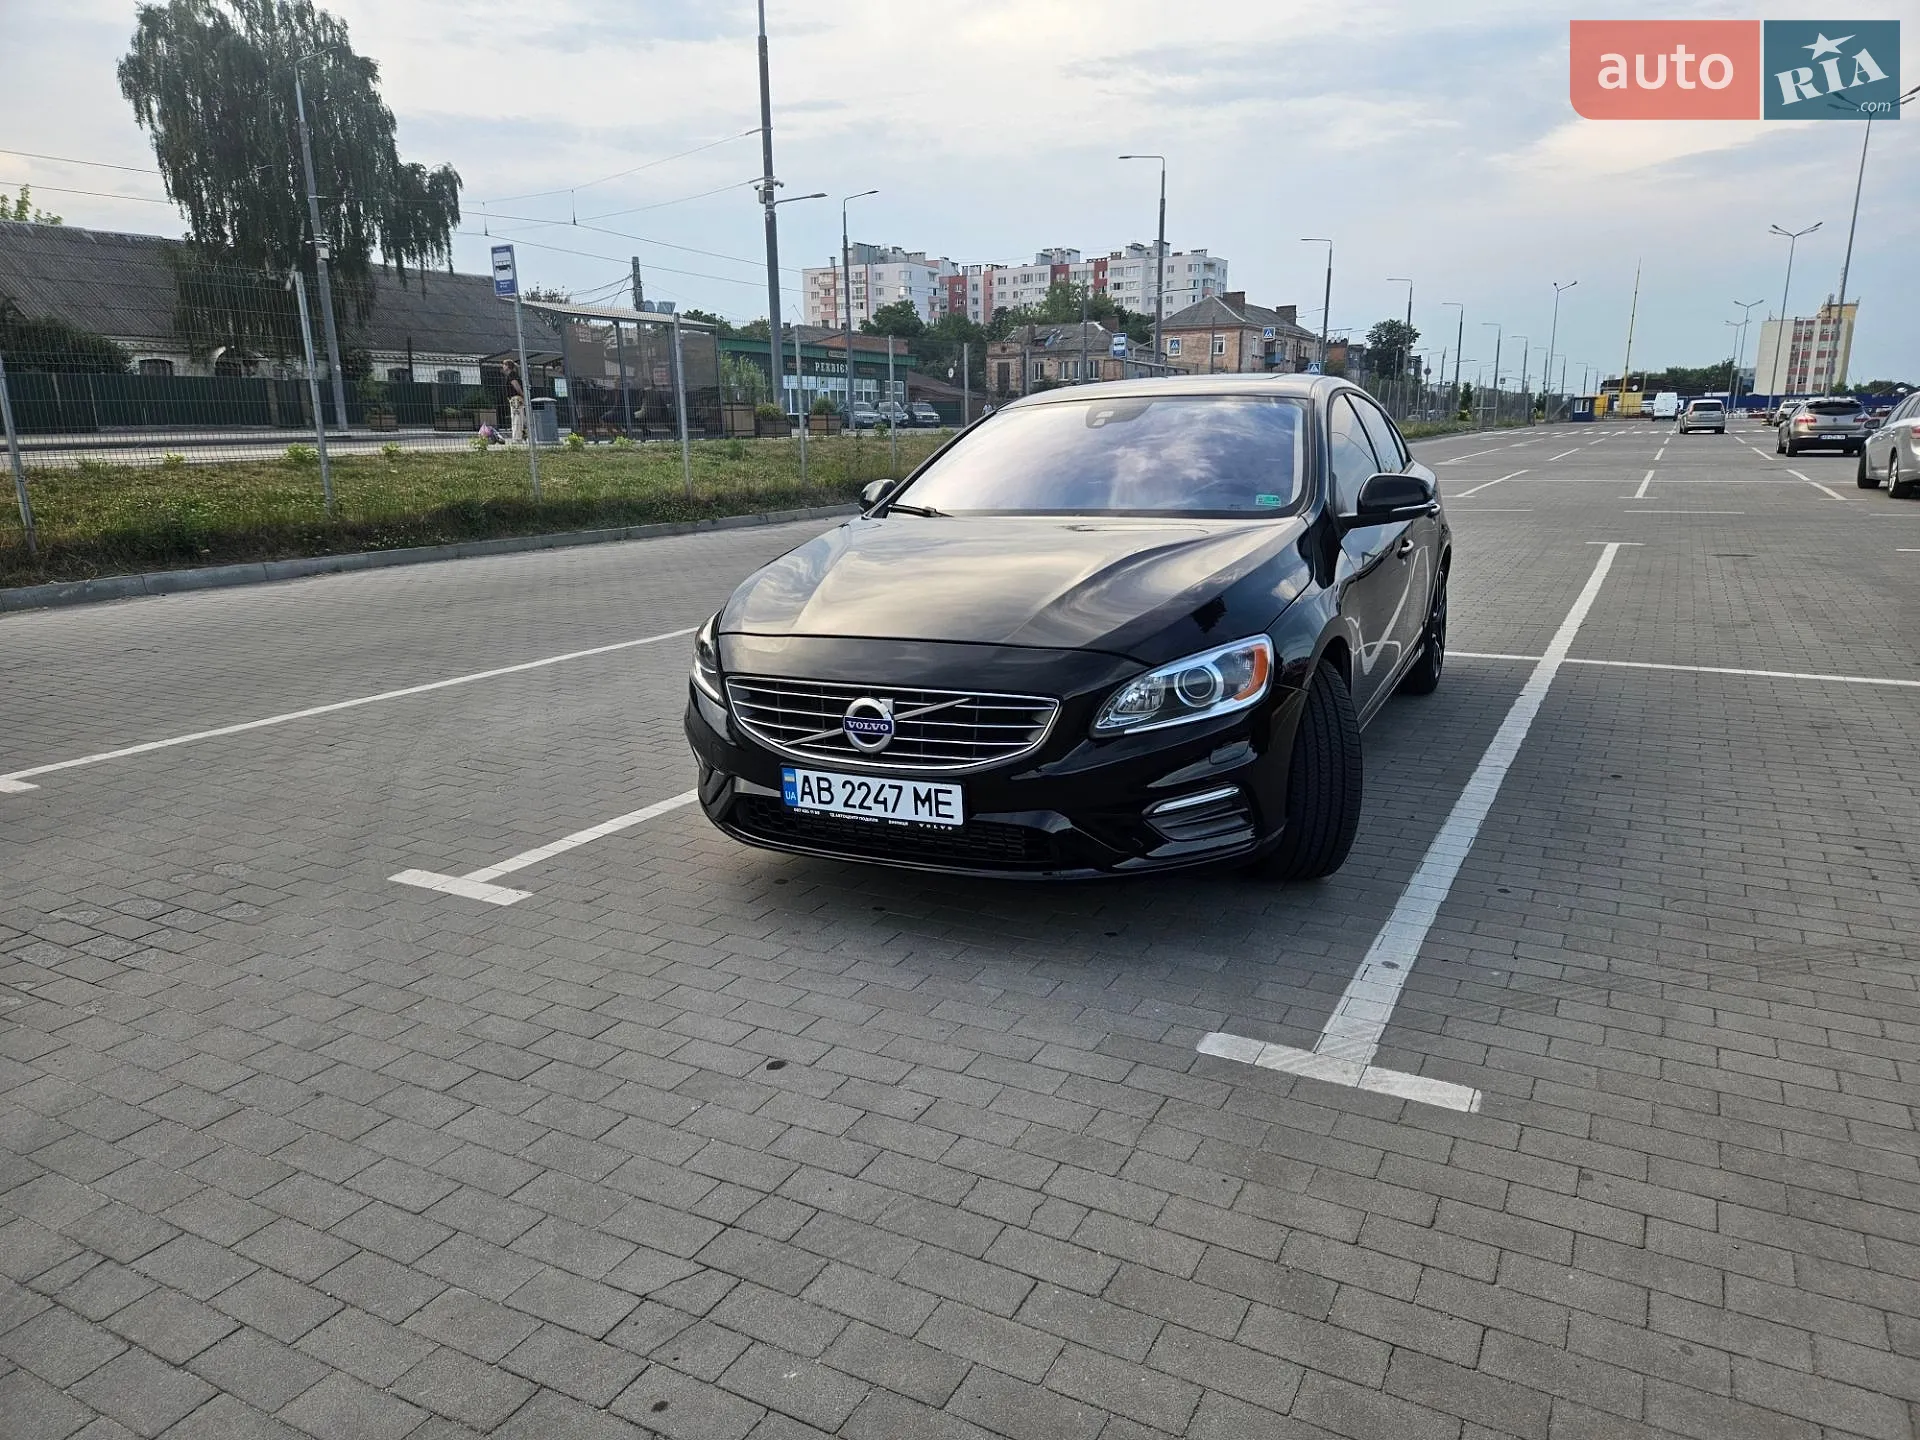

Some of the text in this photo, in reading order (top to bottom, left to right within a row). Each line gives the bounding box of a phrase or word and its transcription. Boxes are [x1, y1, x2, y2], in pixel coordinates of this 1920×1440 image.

[846, 720, 889, 731] VOLVO
[785, 791, 797, 801] UA
[799, 775, 954, 819] AB 2247 ME
